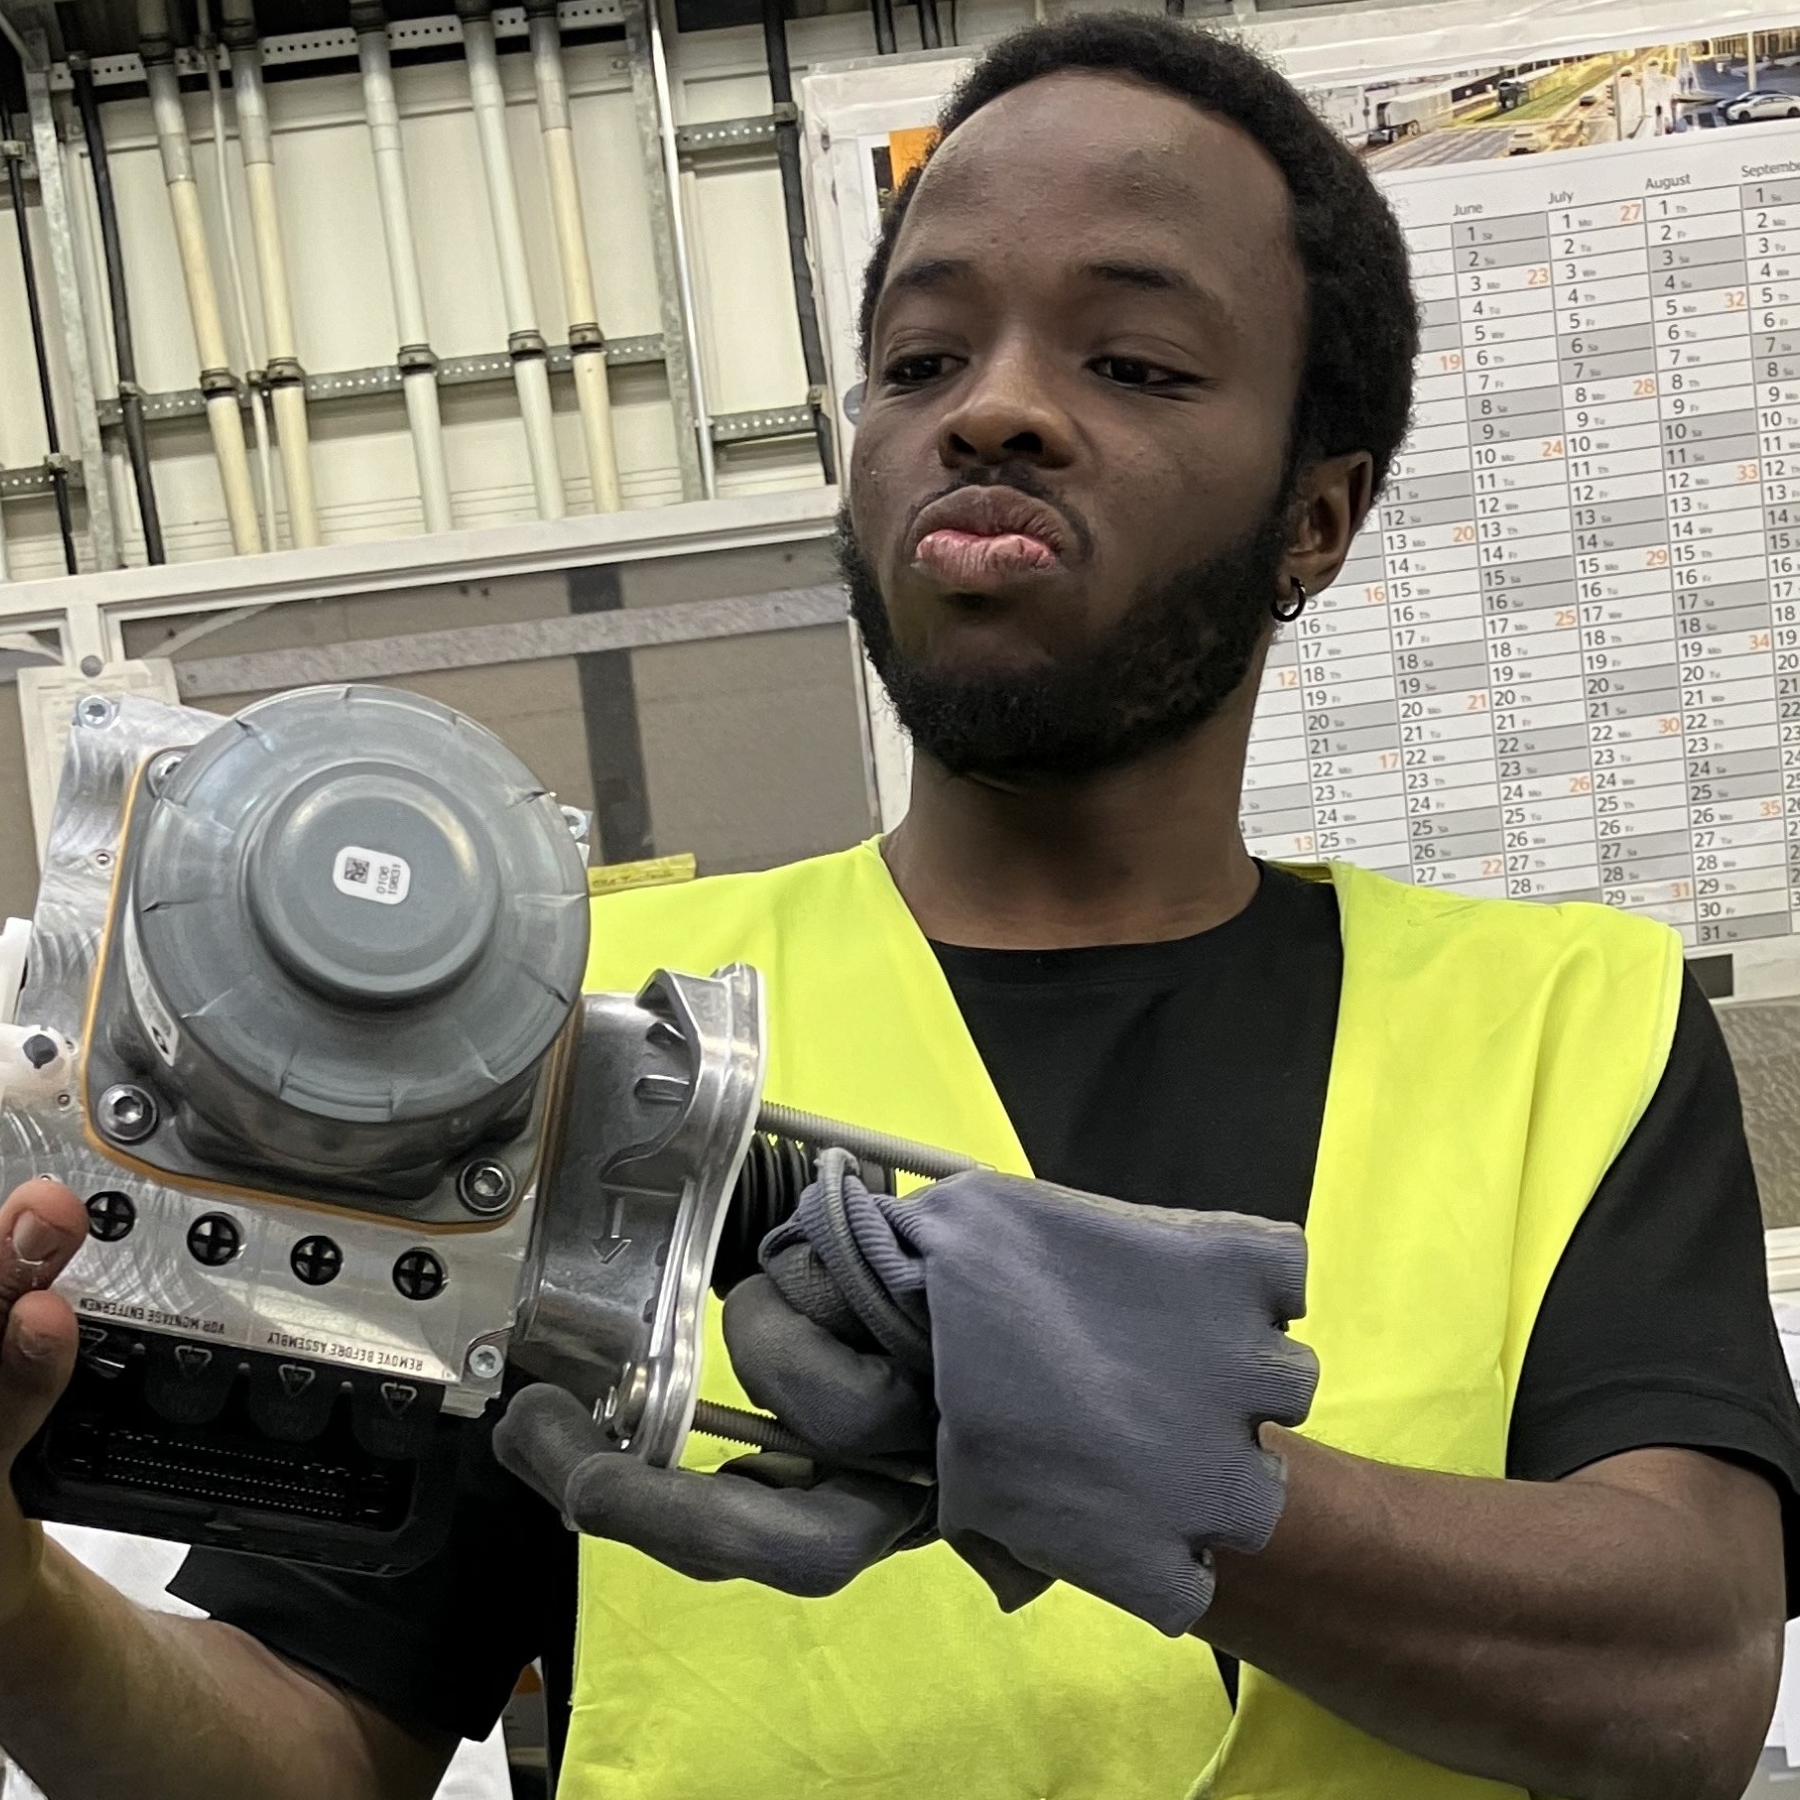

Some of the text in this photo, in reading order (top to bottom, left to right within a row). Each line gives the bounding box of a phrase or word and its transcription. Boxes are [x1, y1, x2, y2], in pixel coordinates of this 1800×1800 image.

[1645, 174, 1691, 190] August
[1547, 190, 1574, 204] July
[1756, 188, 1764, 202] 1
[1453, 203, 1483, 216] June
[1660, 200, 1668, 215] 1
[1562, 204, 1641, 229] 1 27
[1757, 212, 1768, 228] 2
[1468, 226, 1474, 241] 1
[1661, 224, 1672, 241] 2
[1564, 238, 1574, 255] 2
[1759, 237, 1769, 254] 3
[1469, 251, 1479, 267] 2
[1663, 250, 1673, 266] 3
[1566, 263, 1576, 280] 3
[1760, 262, 1771, 277] 4
[1470, 268, 1550, 292] 3 23
[1664, 274, 1675, 289] 4
[1568, 288, 1578, 304] 4
[1666, 292, 1745, 316] 5 32
[1762, 287, 1773, 304] 5
[1472, 300, 1483, 315] 4
[1570, 312, 1581, 329] 5
[1764, 312, 1776, 328] 6
[1475, 325, 1486, 341] 5
[1668, 324, 1680, 340] 6
[1571, 338, 1583, 354] 6
[1766, 336, 1776, 352] 7
[1440, 354, 1462, 370] 19
[1476, 350, 1488, 366] 6
[1670, 349, 1680, 365] 7
[1574, 362, 1584, 378] 7
[1767, 362, 1778, 377] 8
[1479, 374, 1489, 390] 7
[1575, 378, 1655, 403] 8 28
[1672, 374, 1683, 390] 8
[1768, 386, 1780, 402] 9
[1481, 399, 1492, 415] 8
[1673, 398, 1685, 415] 9
[1577, 411, 1588, 428] 9
[1762, 410, 1782, 428] 10
[1482, 424, 1494, 440] 9
[1666, 423, 1686, 440] 10
[1475, 440, 1563, 465] 10 24
[1569, 436, 1591, 453] 10
[1763, 436, 1781, 452] 11
[1667, 448, 1686, 465] 11
[1572, 461, 1590, 477] 11
[1765, 459, 1784, 476] 12
[1477, 473, 1495, 489] 11
[1668, 464, 1758, 489] 12 33
[1574, 484, 1594, 501] 12
[1767, 484, 1786, 501] 13
[1479, 497, 1499, 514] 12
[1670, 496, 1691, 513] 13
[1384, 509, 1404, 526] 12
[1575, 509, 1596, 526] 13
[1481, 521, 1501, 538] 13
[1672, 521, 1693, 538] 14
[1386, 526, 1476, 551] 13 20
[1577, 534, 1598, 550] 14
[1770, 532, 1790, 550] 15
[1482, 546, 1503, 562] 14
[1579, 548, 1669, 574] 15 29
[1674, 544, 1696, 562] 15
[1389, 558, 1409, 575] 14
[1772, 556, 1792, 574] 16
[1484, 570, 1505, 586] 15
[1364, 586, 1385, 602] 16
[1390, 582, 1412, 598] 15
[1581, 582, 1602, 598] 16
[1487, 594, 1508, 610] 16
[1678, 593, 1698, 610] 17
[1393, 606, 1414, 622] 16
[1488, 608, 1577, 634] 17 25
[1583, 606, 1602, 622] 17
[1775, 605, 1796, 622] 18
[1300, 618, 1320, 635] 16
[1395, 630, 1415, 646] 17
[1681, 634, 1770, 658] 19 34
[1302, 642, 1322, 659] 17
[1490, 642, 1512, 658] 18
[1398, 654, 1418, 670] 18
[1587, 654, 1607, 670] 19
[1278, 671, 1297, 686] 12
[1304, 666, 1325, 682] 18
[1682, 665, 1704, 682] 20
[1399, 677, 1420, 694] 19
[1306, 690, 1327, 706] 19
[1401, 694, 1486, 718] 20 21
[1494, 689, 1516, 706] 20
[1684, 689, 1703, 706] 21
[1589, 702, 1608, 718] 21
[1308, 714, 1329, 731] 20
[1496, 714, 1515, 730] 21
[1592, 716, 1681, 742] 22 30
[1403, 726, 1422, 742] 21
[1310, 738, 1329, 754] 21
[1688, 736, 1709, 754] 23
[1313, 753, 1398, 778] 22 17
[1406, 748, 1426, 766] 22
[1594, 748, 1615, 766] 23
[1500, 760, 1521, 778] 23
[1408, 772, 1428, 790] 23
[1502, 774, 1592, 801] 24 26
[1315, 785, 1335, 802] 23
[1691, 784, 1712, 801] 25
[1410, 796, 1430, 813] 24
[1598, 795, 1618, 813] 25
[1692, 800, 1781, 825] 26 35
[1317, 808, 1338, 825] 24
[1504, 807, 1526, 825] 25
[1412, 820, 1433, 836] 25
[1294, 836, 1313, 851] 13
[1319, 832, 1340, 849] 25
[1694, 831, 1715, 848] 27
[1414, 843, 1436, 860] 26
[1601, 842, 1621, 860] 27
[1416, 859, 1502, 883] 27 22
[1509, 854, 1529, 872] 27
[1603, 866, 1624, 883] 28
[1511, 878, 1532, 895] 28
[1605, 882, 1690, 906] 29 31
[1698, 878, 1719, 895] 29
[1700, 901, 1721, 918] 30
[1702, 926, 1719, 941] 31
[203, 1321, 225, 1334] VOR
[267, 1331, 423, 1371] REMOVE BEFORE ASSEMBLY
